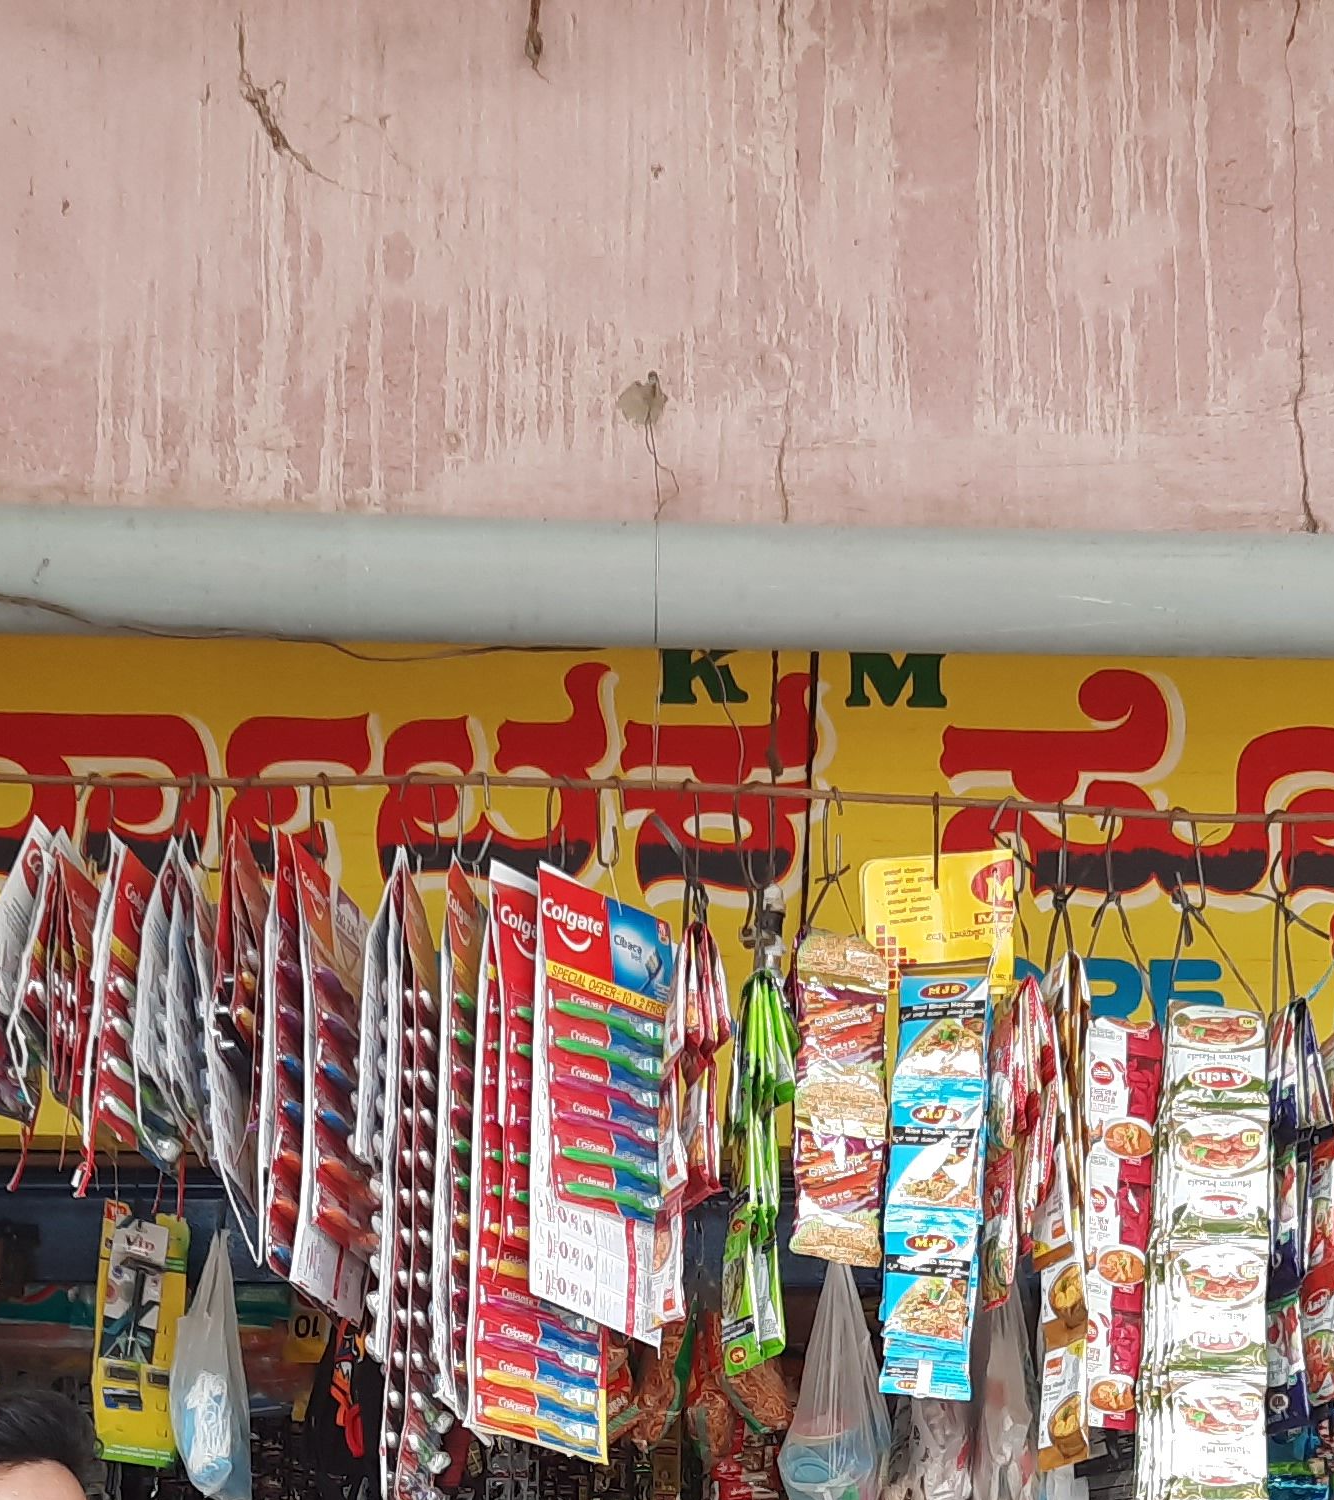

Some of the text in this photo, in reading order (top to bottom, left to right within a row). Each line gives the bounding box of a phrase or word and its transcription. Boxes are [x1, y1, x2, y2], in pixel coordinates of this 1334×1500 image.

[845, 652, 947, 708] M
[541, 897, 604, 938] Colgate
[551, 965, 587, 986] SPECIAL
[1193, 1070, 1247, 1085] Aachi
